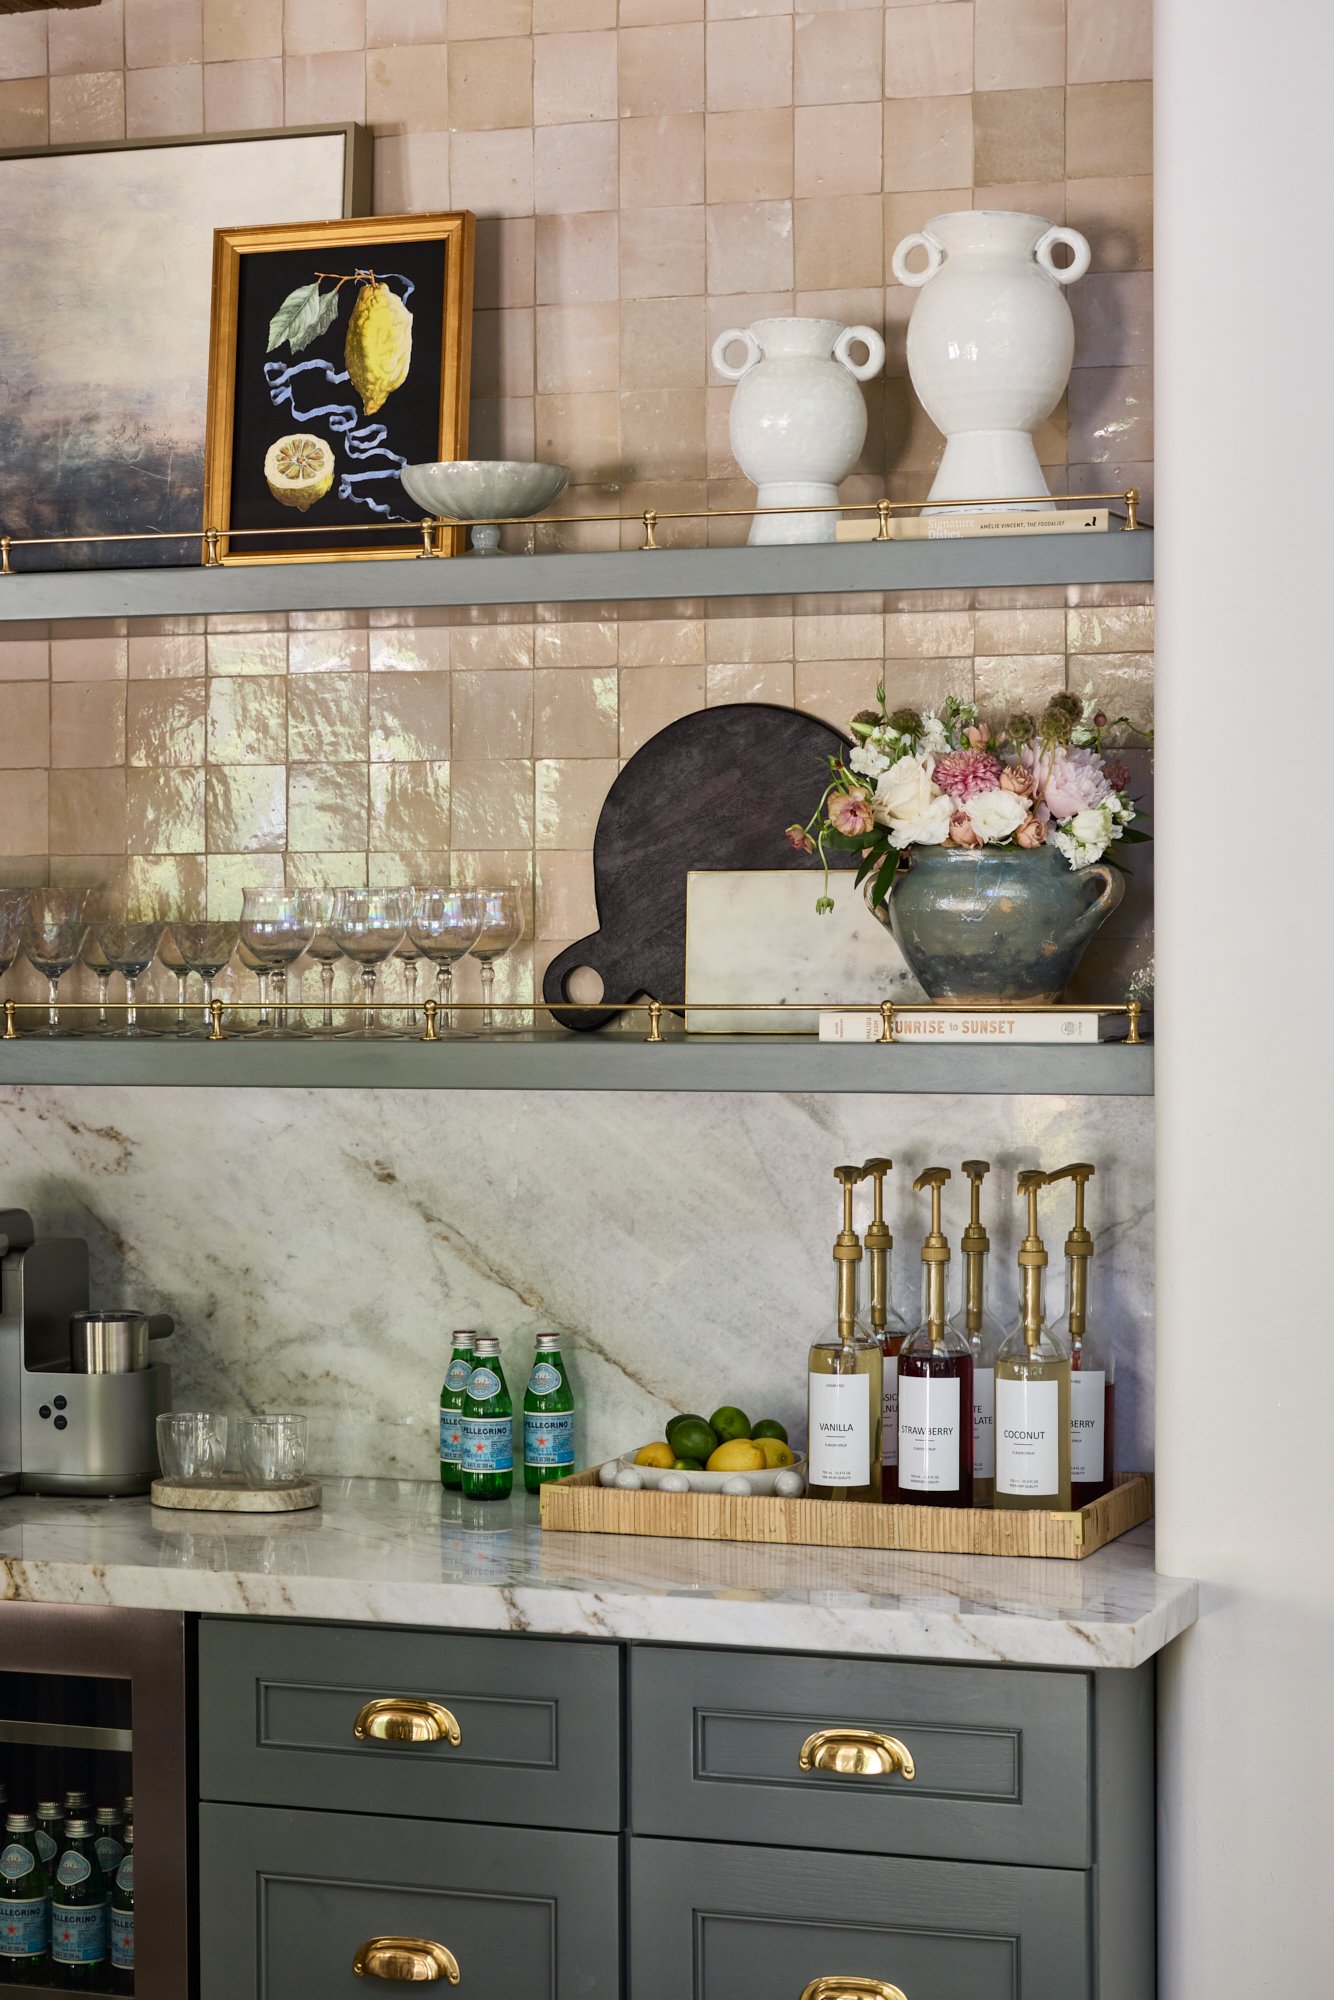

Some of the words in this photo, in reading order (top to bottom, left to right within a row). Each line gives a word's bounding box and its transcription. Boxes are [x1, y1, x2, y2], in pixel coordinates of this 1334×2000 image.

[928, 518, 975, 530] Signature
[980, 522, 1000, 530] AMÉLIE
[928, 529, 964, 540] Dishes.
[950, 1022, 958, 1031] to
[962, 1020, 1015, 1034] SUNSET
[819, 1422, 854, 1432] VANILLA
[901, 1425, 954, 1436] STRAWBERRY
[1003, 1429, 1046, 1440] COCONUT
